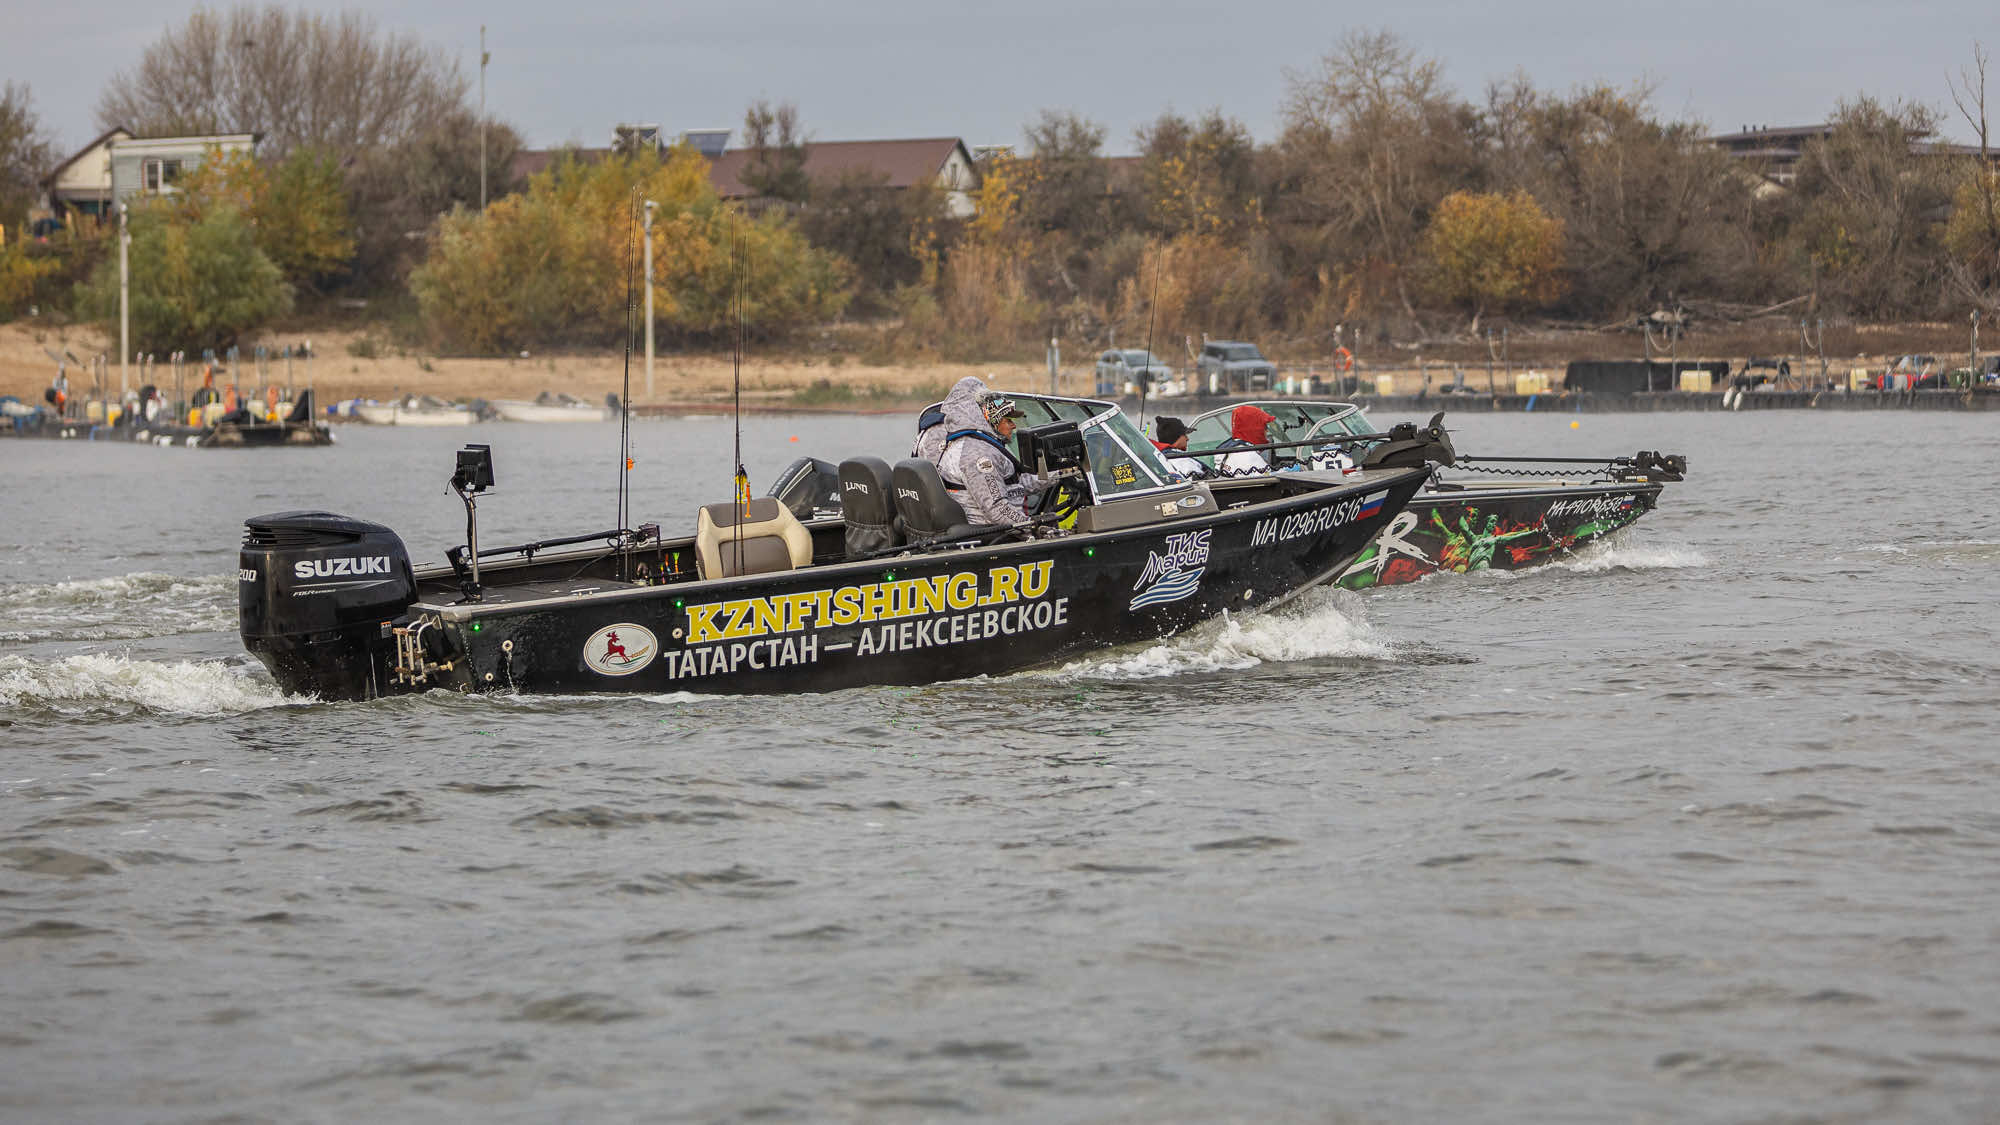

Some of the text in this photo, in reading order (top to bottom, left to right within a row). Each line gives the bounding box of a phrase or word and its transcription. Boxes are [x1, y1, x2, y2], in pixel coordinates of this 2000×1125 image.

[845, 481, 869, 495] LUND
[897, 487, 920, 502] LUND
[1165, 528, 1212, 555] ТИС
[294, 556, 391, 579] SUZUKI
[685, 559, 1055, 645] KZNFISHING.RU
